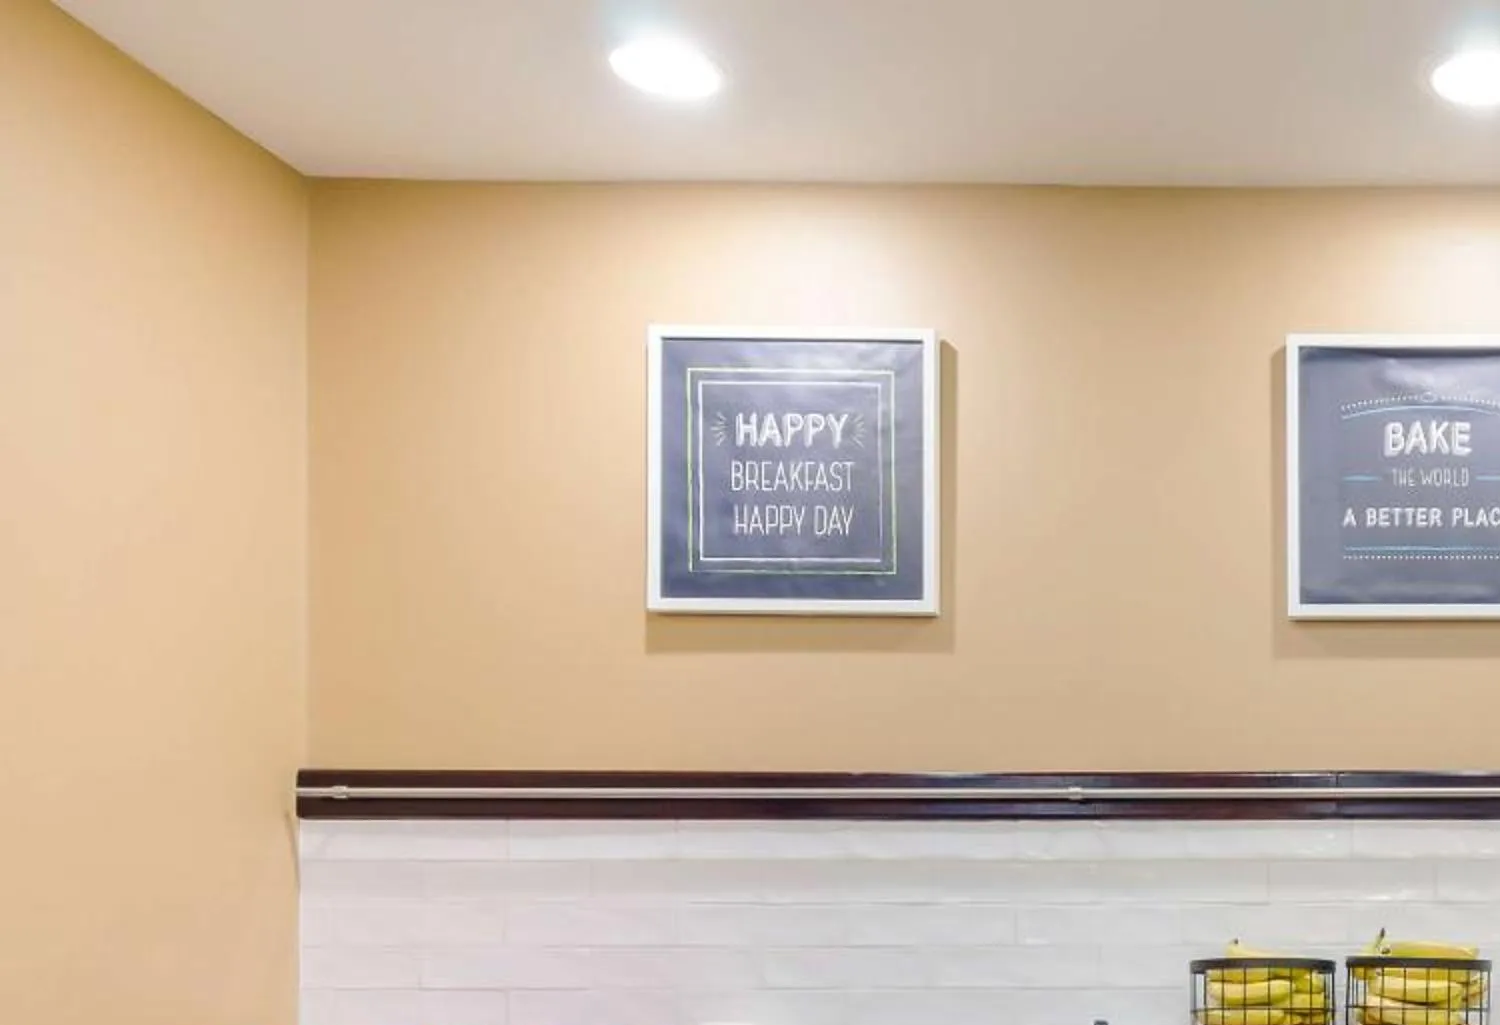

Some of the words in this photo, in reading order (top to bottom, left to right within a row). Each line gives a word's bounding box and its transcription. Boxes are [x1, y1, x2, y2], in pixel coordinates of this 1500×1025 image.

[735, 412, 849, 448] HAPPY
[1384, 420, 1472, 456] BAKE
[730, 461, 855, 493] BREAKFAST
[1391, 468, 1416, 487] THE
[1421, 468, 1470, 487] WORLD
[733, 505, 806, 536] HAPPY
[814, 505, 854, 536] DAY
[1342, 507, 1357, 528] A
[1366, 507, 1443, 528] BETTER
